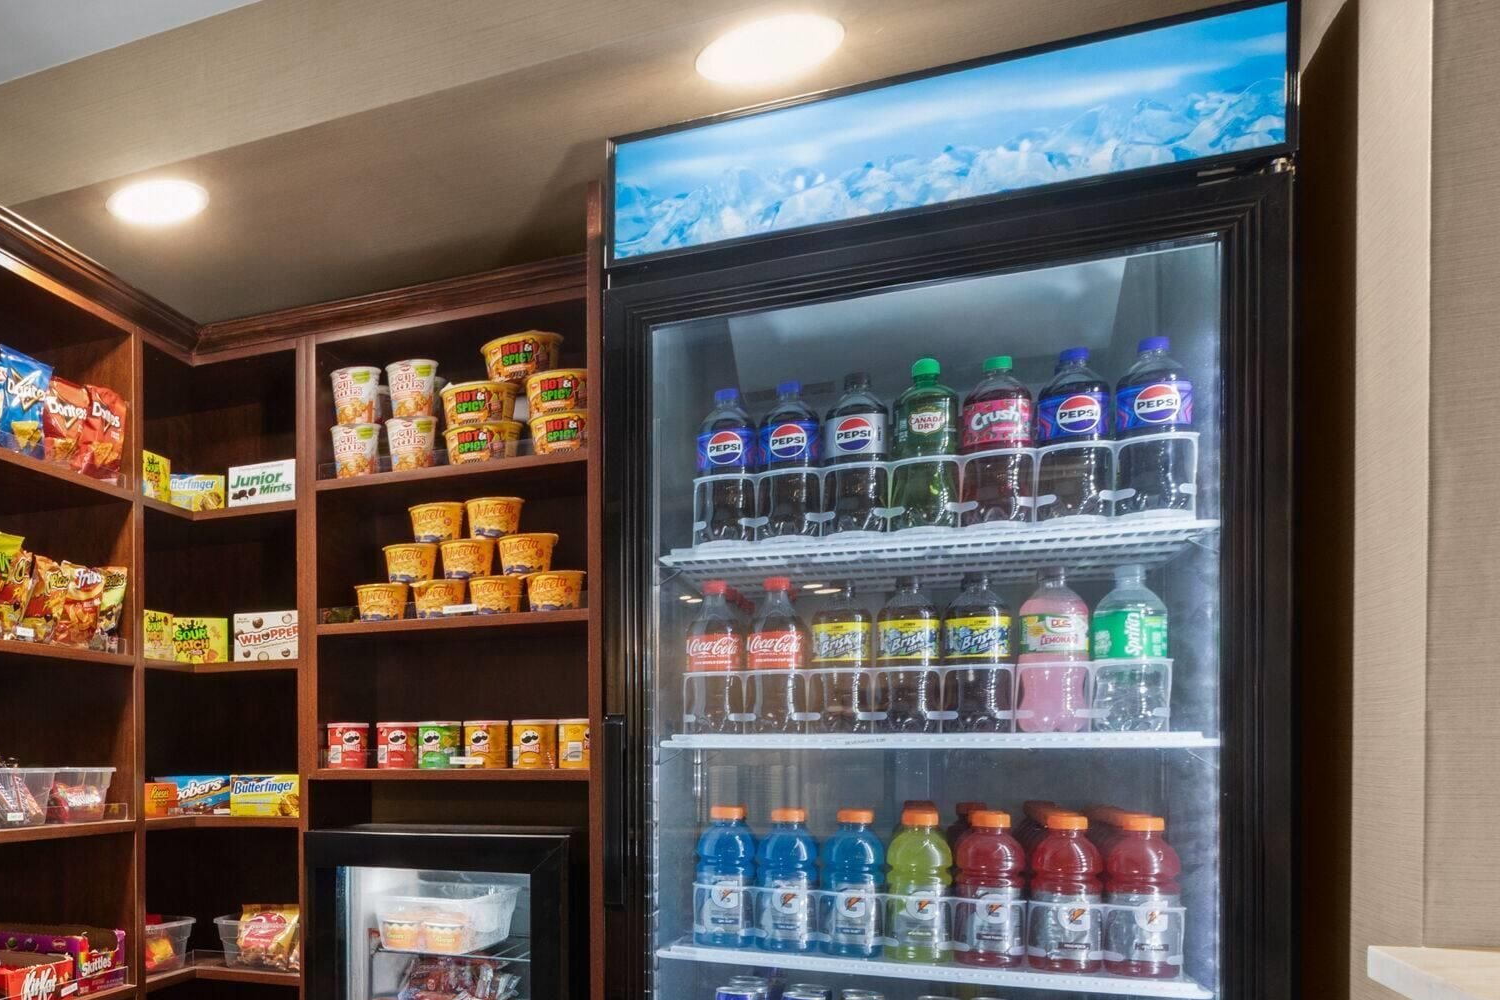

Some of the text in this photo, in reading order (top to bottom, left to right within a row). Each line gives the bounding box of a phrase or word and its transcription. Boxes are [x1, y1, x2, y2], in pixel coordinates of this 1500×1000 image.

[501, 342, 525, 355] HOT
[502, 351, 533, 367] SPICY
[541, 378, 563, 391] HOT
[455, 389, 478, 403] HOT
[541, 388, 572, 402] SPICY
[48, 396, 87, 423] Doritos
[455, 401, 485, 413] SPICY
[1137, 398, 1178, 410] PEPSI
[91, 401, 120, 429] Doritos
[910, 414, 943, 425] CANADA
[970, 404, 1023, 431] Crush
[1059, 409, 1099, 420] PEPSI
[546, 419, 569, 432] HOT
[917, 422, 937, 432] DRY
[457, 430, 479, 443] HOT
[547, 428, 578, 441] SPICY
[771, 434, 805, 448] PEPSI
[836, 429, 872, 441] PEPSI
[458, 440, 487, 453] SPICY
[709, 442, 742, 453] PEPSI
[230, 471, 284, 490] Junior
[259, 482, 293, 496] Mints
[173, 626, 209, 641] SOUR
[961, 629, 1002, 651] Brisk
[175, 638, 210, 653] PATCH
[688, 635, 740, 657] Coca-Cola
[750, 633, 803, 655] Coca-Cola
[820, 633, 851, 652] Brisk
[890, 631, 927, 652] Brisk
[233, 780, 295, 795] Butterfinger
[81, 956, 112, 977] Skittles
